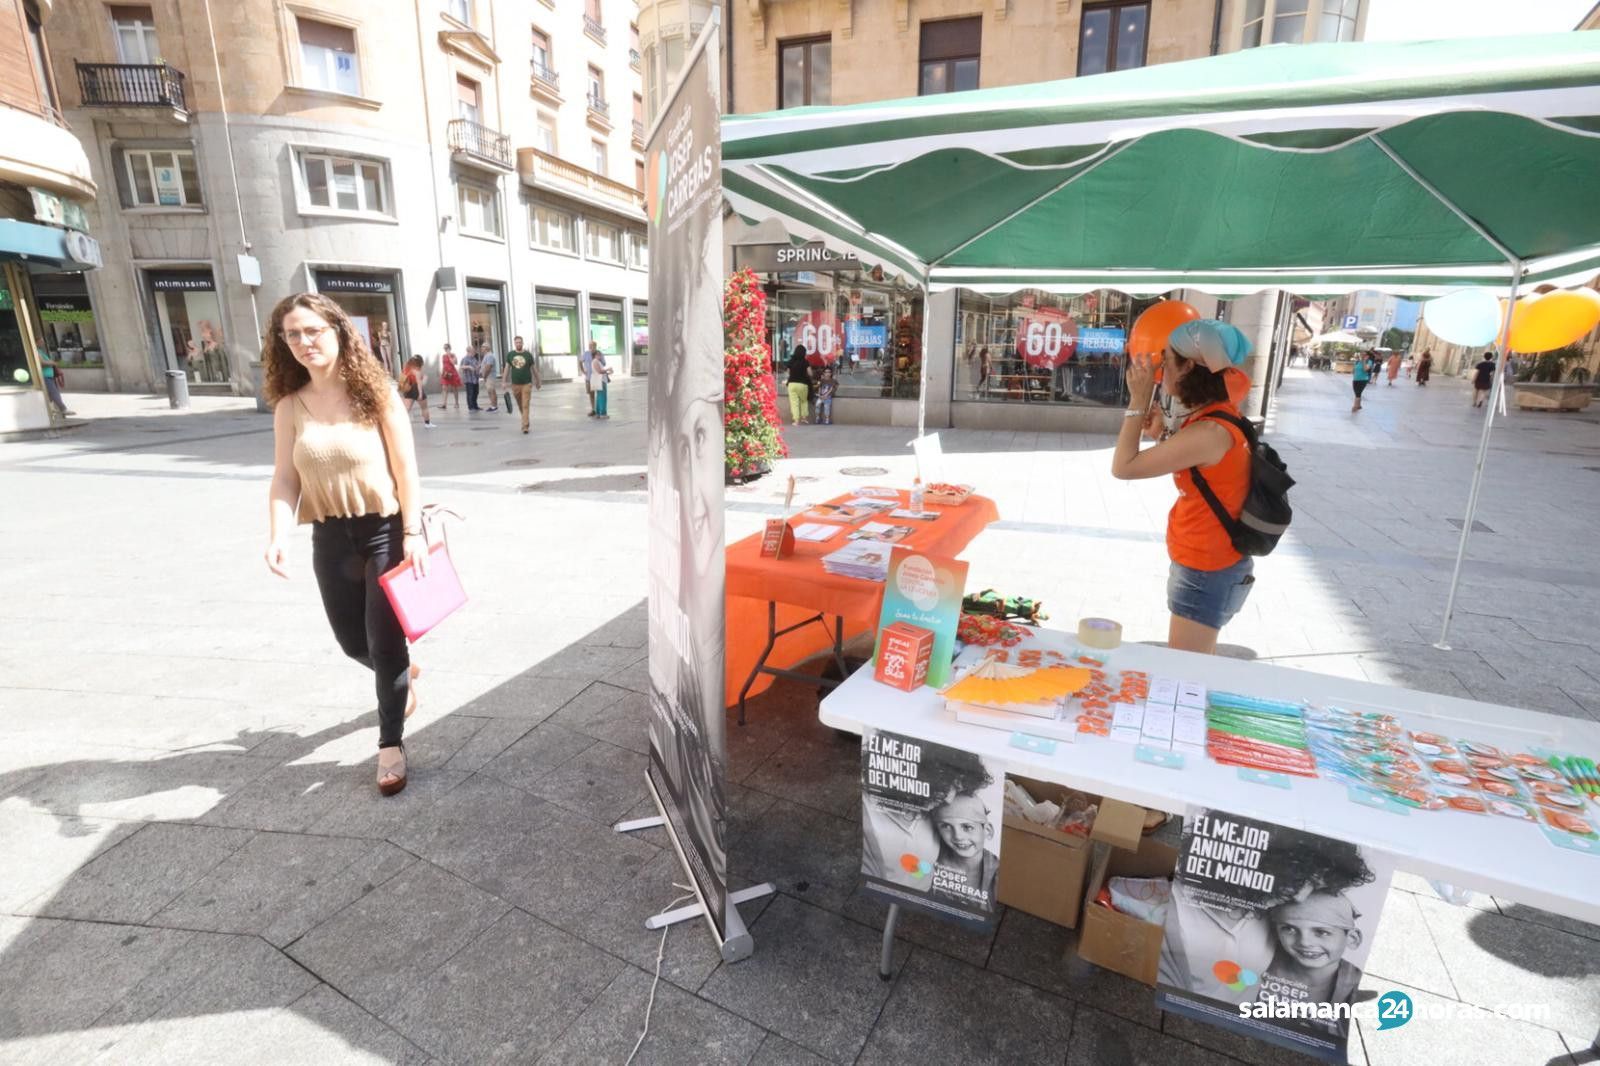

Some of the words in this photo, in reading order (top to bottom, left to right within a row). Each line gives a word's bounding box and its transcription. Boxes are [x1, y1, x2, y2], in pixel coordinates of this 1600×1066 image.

[667, 145, 713, 218] CARRERAS
[154, 280, 212, 288] intimissimi
[1345, 315, 1357, 328] P
[868, 735, 880, 753] EL
[882, 737, 921, 763] MEJOR
[868, 753, 918, 779] ANUNCIO
[868, 769, 888, 788] DEL
[889, 773, 930, 798] MUNDO
[1193, 815, 1210, 837] EL
[1212, 818, 1270, 851] MEJOR
[1189, 836, 1261, 870] ANUNCIO
[934, 869, 968, 884] JOSEP
[1186, 855, 1213, 879] DEL
[1214, 862, 1275, 893] MUNDO
[933, 877, 989, 900] CARRERAS
[1260, 980, 1309, 999] JOSEP
